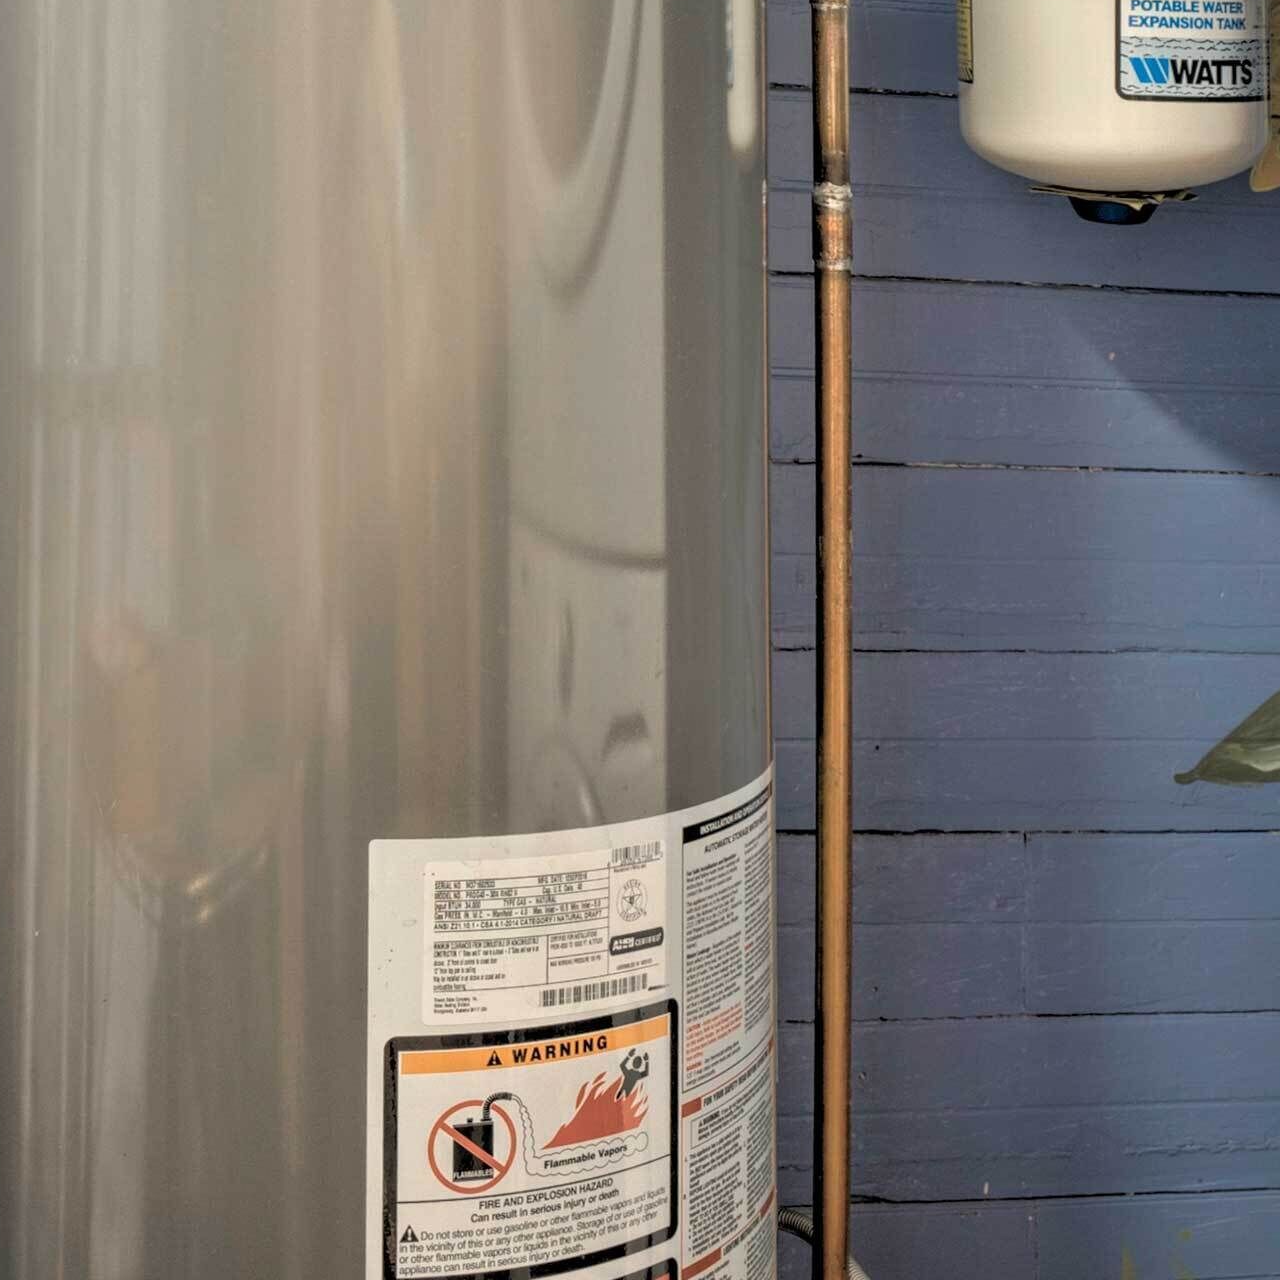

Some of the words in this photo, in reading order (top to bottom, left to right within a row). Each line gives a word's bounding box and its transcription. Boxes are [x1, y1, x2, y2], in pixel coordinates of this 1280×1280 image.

[1130, 0, 1200, 13] POTABLE
[1202, 0, 1244, 14] WATER
[1128, 15, 1214, 30] EXPANSION
[1216, 17, 1247, 31] TANK
[1170, 58, 1253, 86] WATTS
[556, 911, 583, 922] NATURAL
[584, 910, 602, 919] DRAFT
[512, 1035, 608, 1065] WARNING
[544, 1152, 596, 1170] Flammable
[598, 1143, 628, 1159] Vapors
[452, 1168, 494, 1179] FLAMMABLES
[470, 1212, 489, 1224] Can
[491, 1209, 517, 1221] result
[519, 1207, 528, 1217] in
[530, 1204, 562, 1216] serious
[563, 1197, 586, 1210] injury
[588, 1195, 597, 1204] or
[599, 1188, 620, 1201] death
[479, 1199, 501, 1210] FIRE
[503, 1196, 524, 1208] AND
[526, 1185, 578, 1205] EXPLOSION
[580, 1177, 614, 1193] HAZARD
[420, 1230, 434, 1241] Do
[436, 1230, 450, 1240] not
[452, 1227, 474, 1239] store
[475, 1227, 485, 1236] or
[487, 1225, 502, 1236] use
[504, 1221, 538, 1234] gasoline
[540, 1218, 549, 1227] or
[551, 1214, 570, 1226] other
[571, 1204, 609, 1221] flammable
[610, 1198, 632, 1211] vapors
[633, 1194, 646, 1205] and
[647, 1186, 666, 1200] liquids
[399, 1244, 408, 1253] in
[409, 1243, 424, 1253] the
[426, 1239, 456, 1252] vicinity
[457, 1239, 466, 1249] of
[468, 1237, 483, 1248] this
[484, 1237, 494, 1247] or
[496, 1236, 511, 1247] any
[513, 1232, 534, 1244] other
[576, 1214, 604, 1231] Storage
[606, 1212, 614, 1223] of
[614, 1211, 621, 1221] or
[623, 1207, 635, 1218] use
[636, 1203, 644, 1214] of
[399, 1255, 409, 1265] or
[410, 1253, 434, 1264] other
[436, 1249, 481, 1262] flammable
[482, 1246, 511, 1259] vapors
[513, 1244, 522, 1253] or
[523, 1240, 549, 1253] liquids
[550, 1237, 558, 1246] in
[560, 1234, 572, 1245] the
[573, 1228, 598, 1243] vicinity
[599, 1226, 607, 1237] of
[620, 1220, 628, 1230] or
[628, 1216, 641, 1228] any
[642, 1210, 659, 1222] other
[399, 1263, 442, 1276] appliance
[443, 1262, 460, 1272] can
[462, 1259, 486, 1271] result
[487, 1258, 496, 1267] in
[497, 1254, 528, 1266] serious
[529, 1250, 550, 1264] injury
[552, 1248, 560, 1258] or
